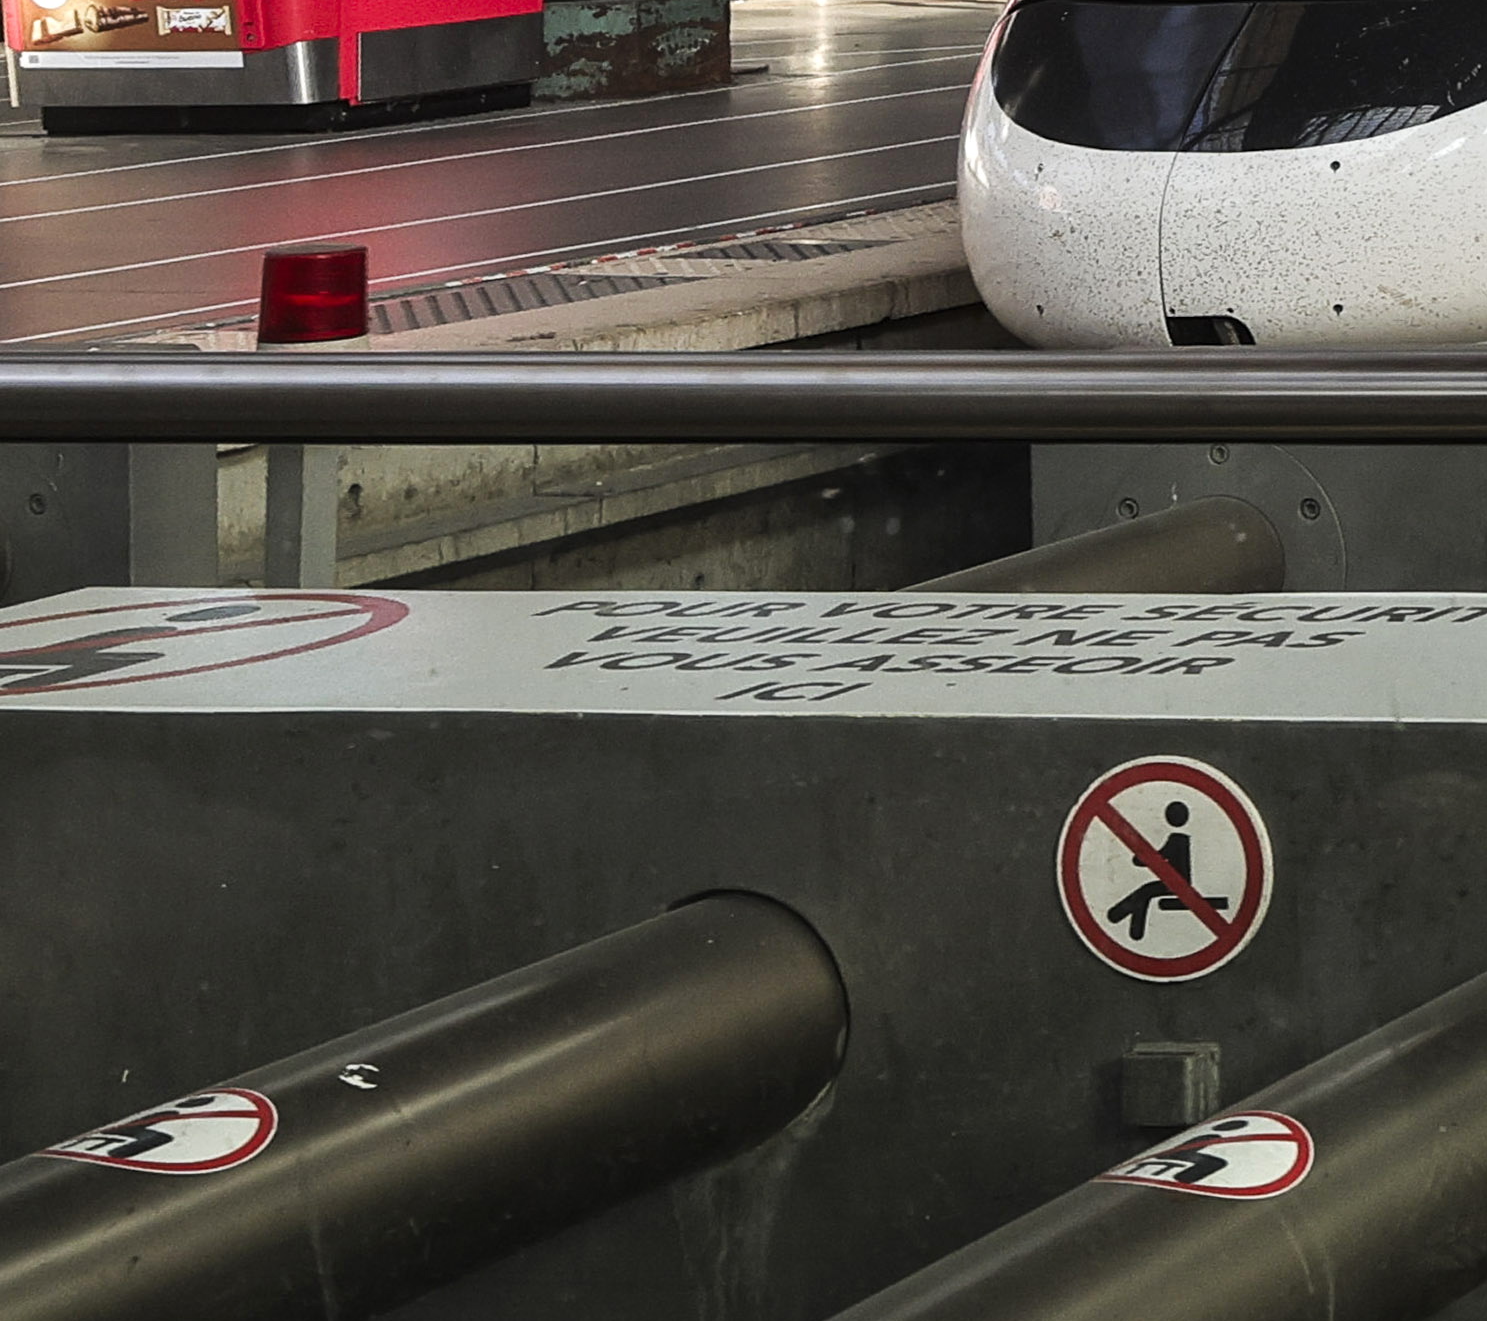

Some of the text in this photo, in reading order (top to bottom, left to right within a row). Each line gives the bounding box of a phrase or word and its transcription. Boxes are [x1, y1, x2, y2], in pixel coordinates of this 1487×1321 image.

[530, 601, 805, 619] POUR
[820, 602, 1123, 620] VOTRE
[586, 625, 1367, 648] VEUILLEZ NE PAS
[543, 651, 1236, 675] VOUS ASSEOIR
[714, 682, 873, 702] ICI
